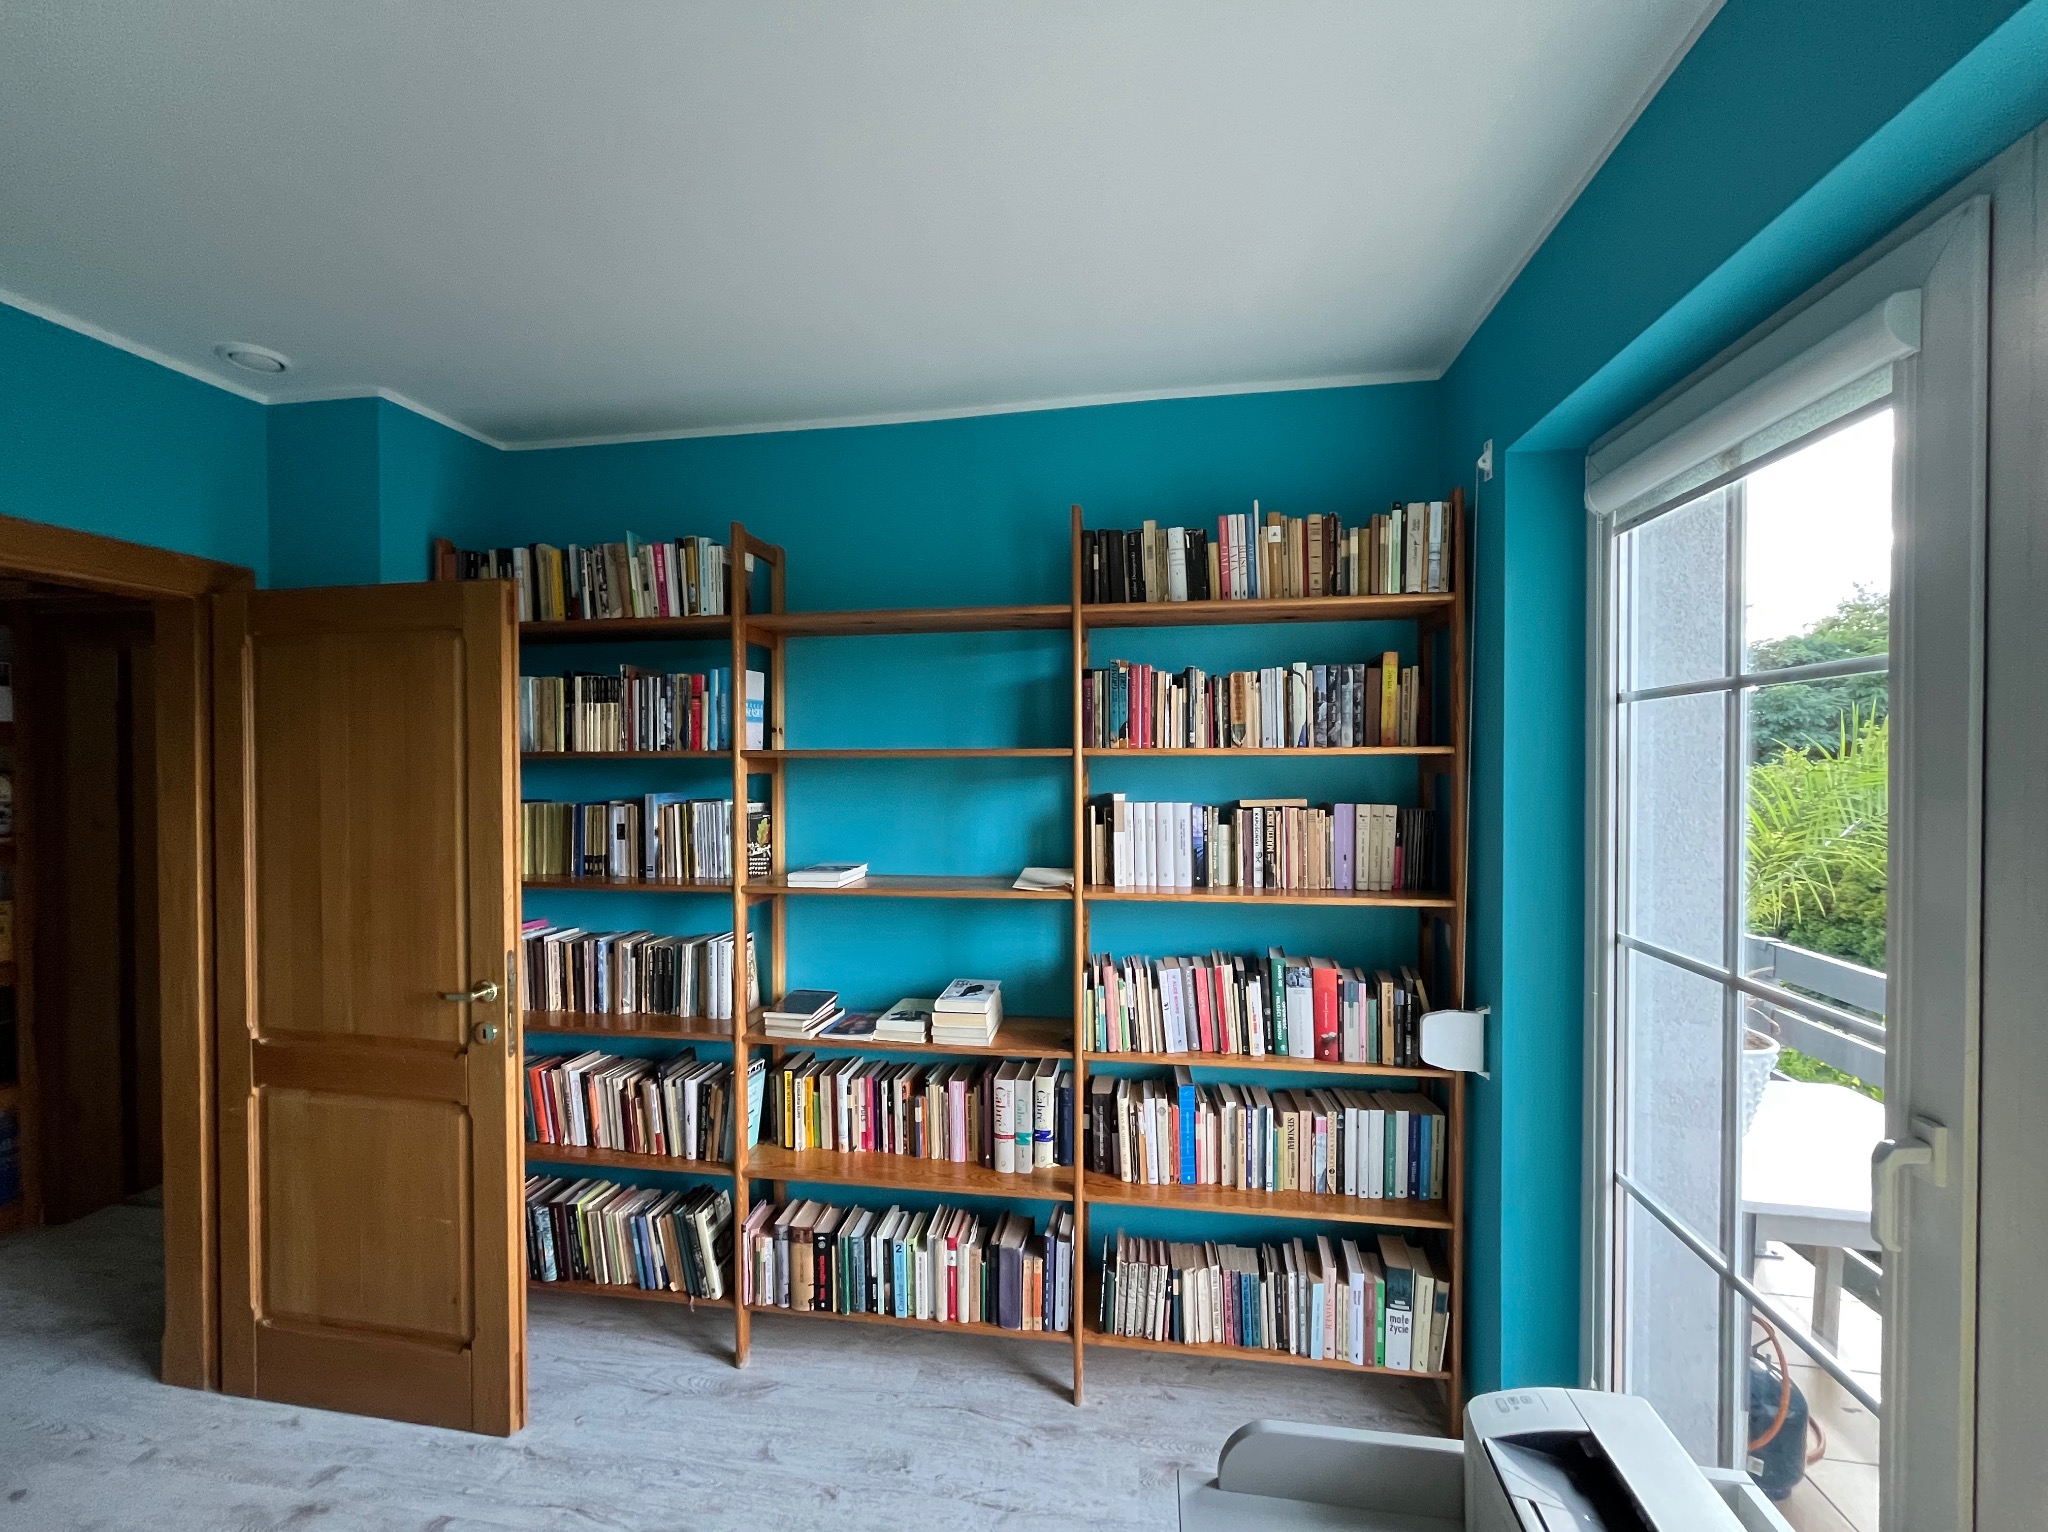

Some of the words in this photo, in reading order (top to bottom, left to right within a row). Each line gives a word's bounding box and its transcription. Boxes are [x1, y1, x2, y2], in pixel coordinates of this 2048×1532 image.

[895, 1244, 903, 1253] 2
[908, 1243, 914, 1253] 1
[1389, 1322, 1409, 1335] życie
